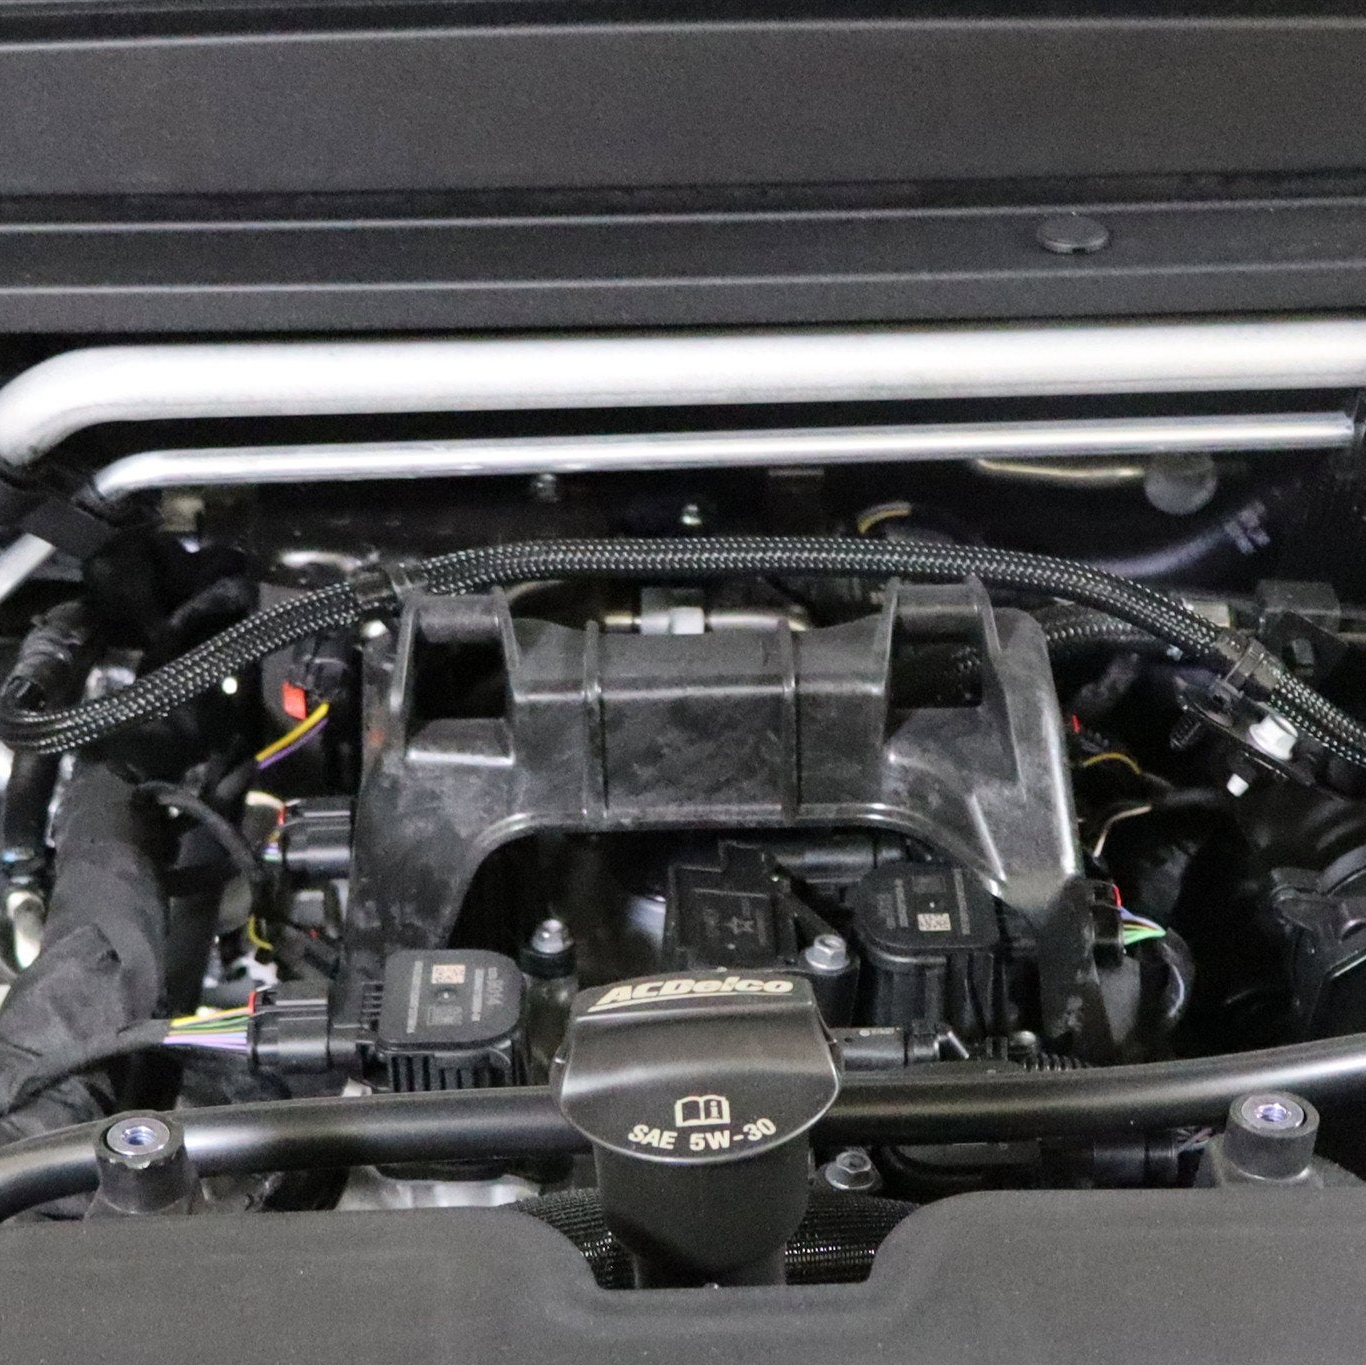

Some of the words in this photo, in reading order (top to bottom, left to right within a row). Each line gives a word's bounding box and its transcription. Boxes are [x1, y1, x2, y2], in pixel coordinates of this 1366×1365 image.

[595, 976, 794, 1005] ACDelco
[628, 1125, 678, 1150] SAE
[689, 1117, 778, 1152] 5W-30
